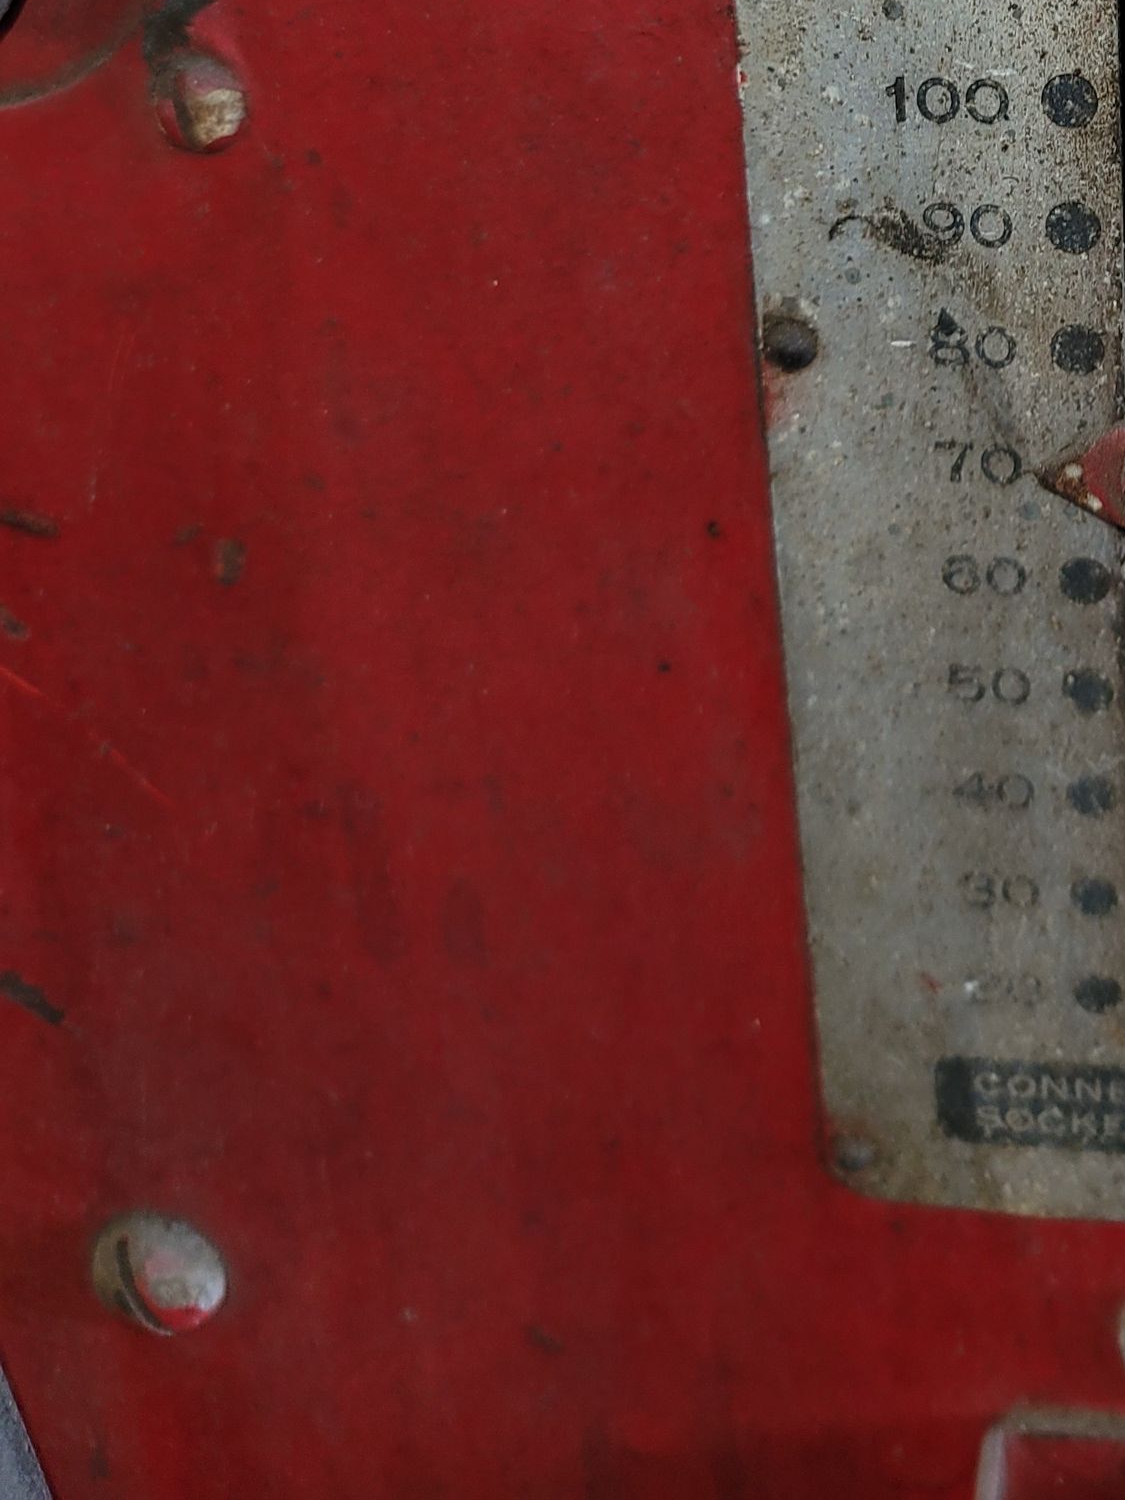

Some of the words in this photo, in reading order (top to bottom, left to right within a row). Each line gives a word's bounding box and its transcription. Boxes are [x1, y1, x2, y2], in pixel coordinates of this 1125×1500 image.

[885, 76, 1010, 125] 100
[922, 202, 1013, 248] 90
[929, 323, 1017, 369] 80
[935, 441, 1022, 485] 70
[948, 663, 1031, 706] 50
[952, 772, 1035, 811] 40
